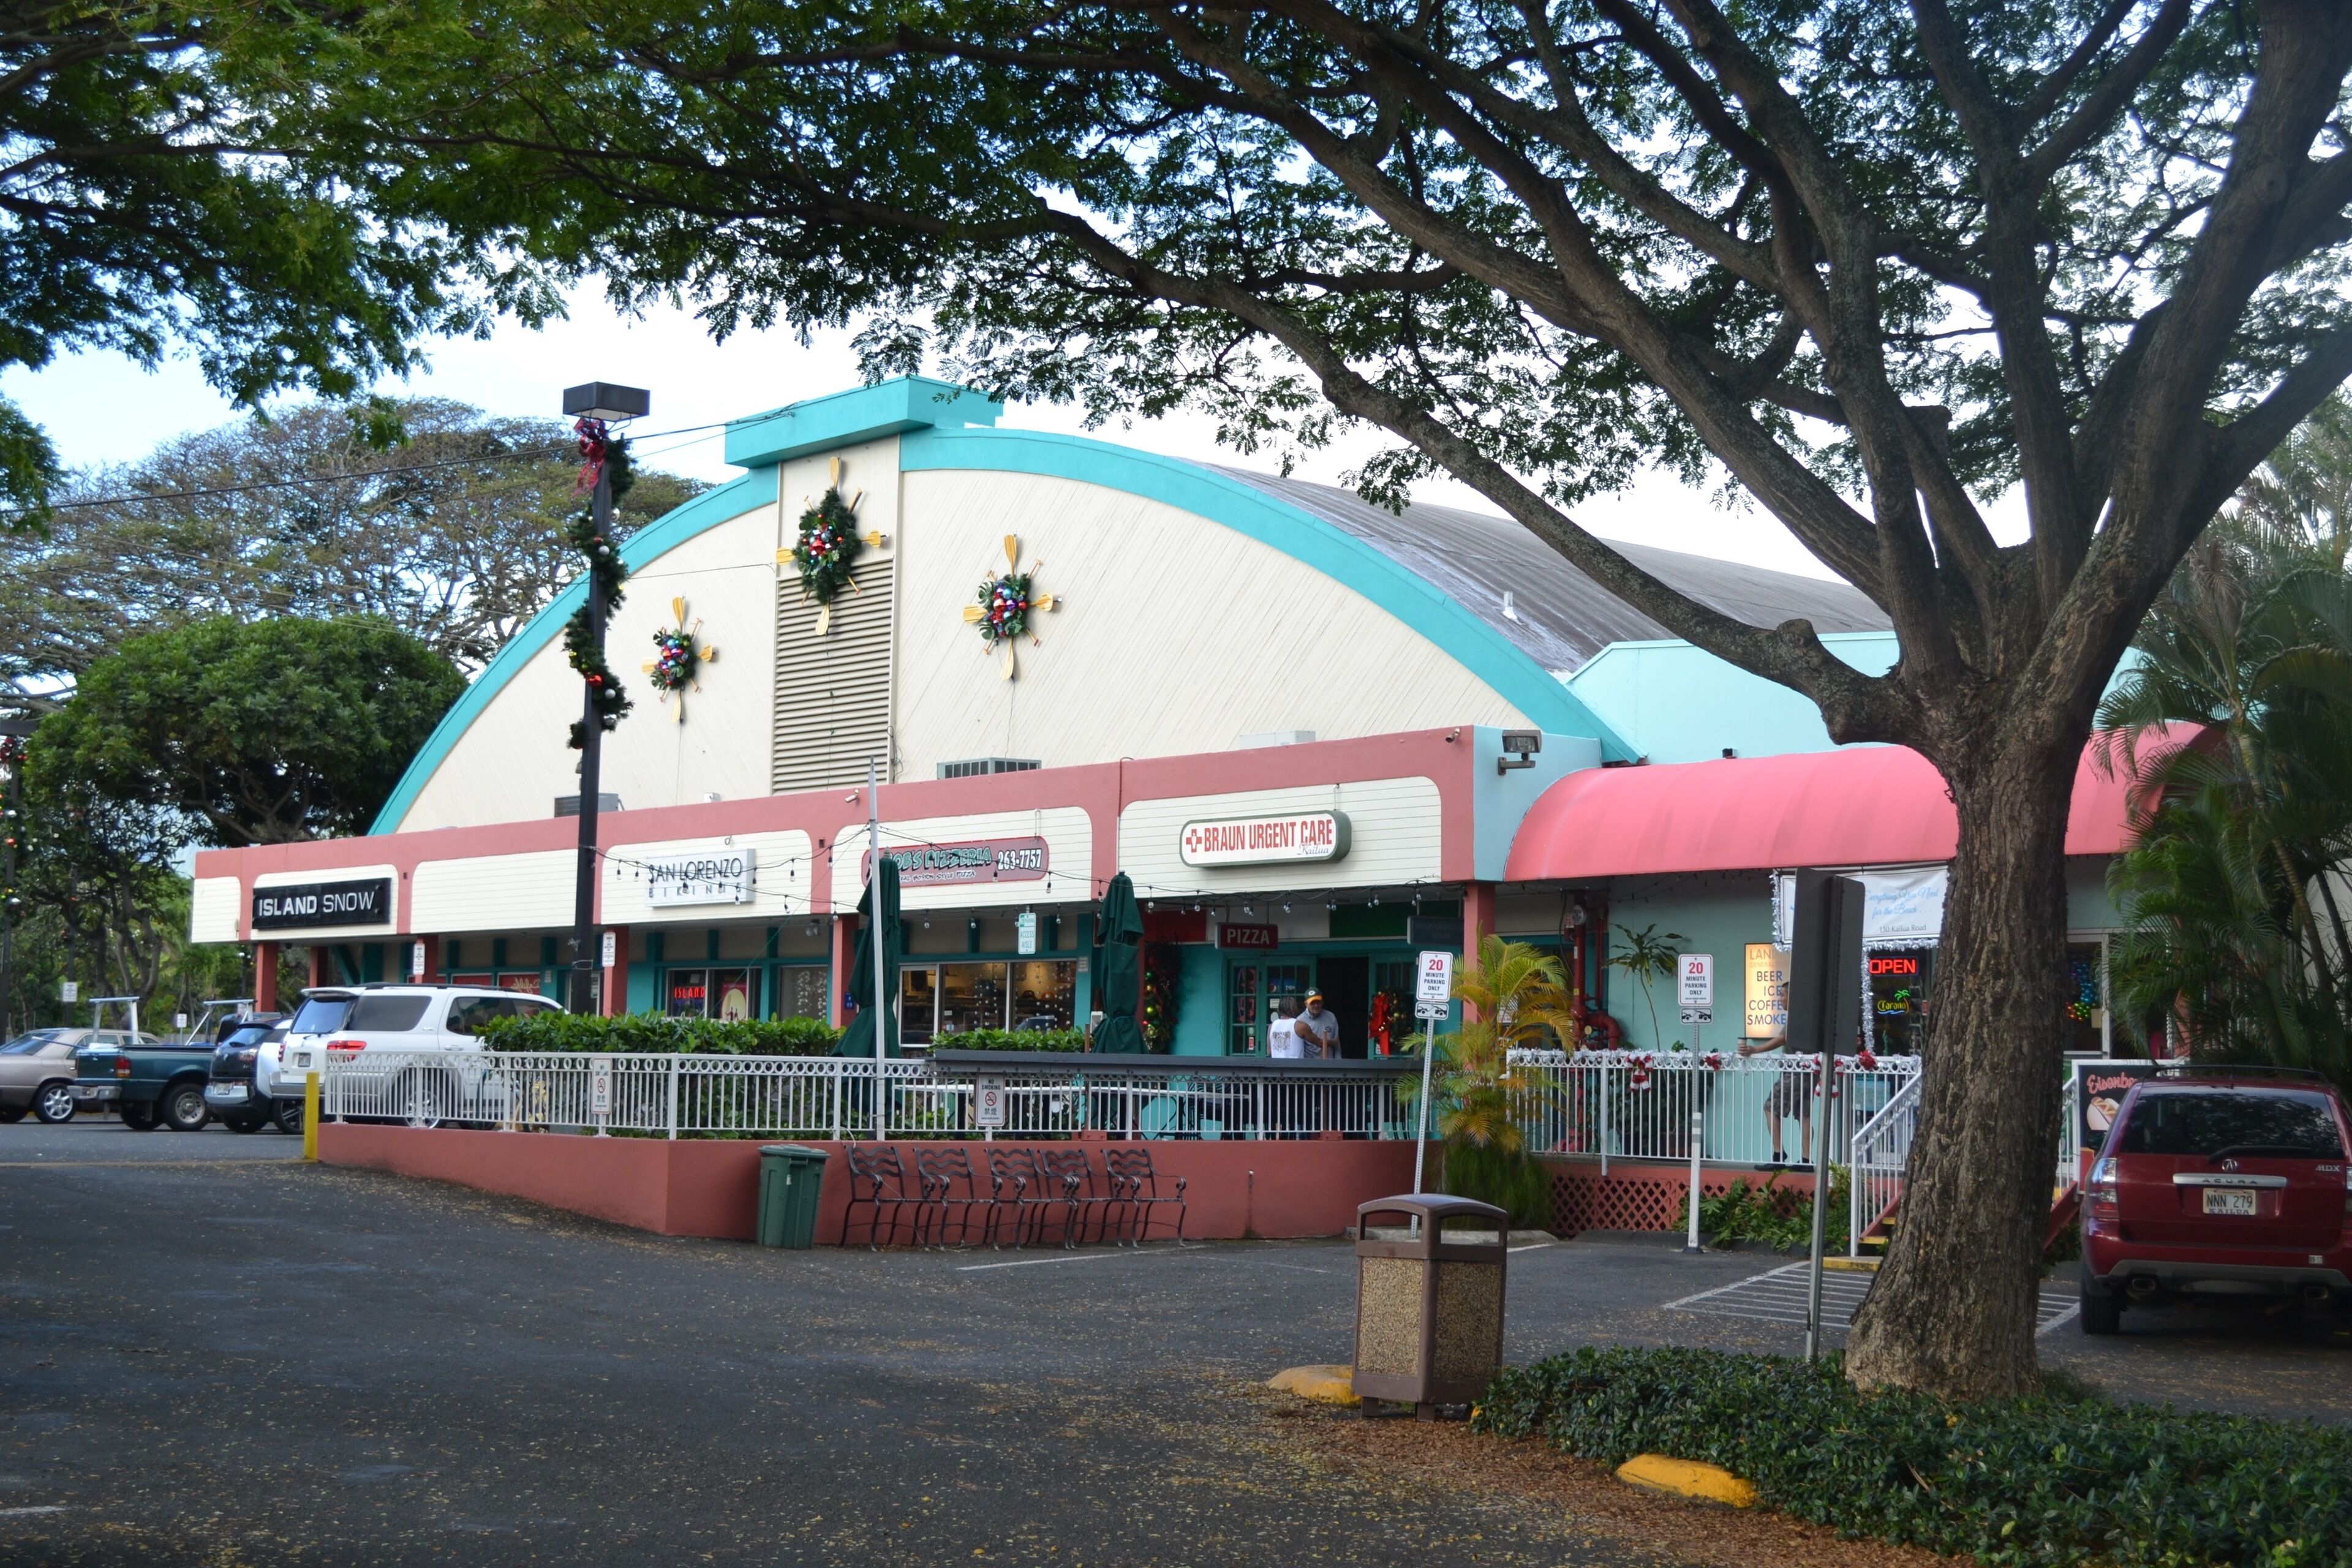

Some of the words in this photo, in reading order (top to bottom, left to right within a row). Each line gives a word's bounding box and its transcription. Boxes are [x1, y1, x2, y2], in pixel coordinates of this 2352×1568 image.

[1204, 825, 1245, 852] BRAUN
[1249, 821, 1297, 850] URGENT
[1300, 819, 1333, 846] CARE
[1297, 842, 1330, 856] Kailua
[889, 850, 922, 872] OB'S
[924, 846, 993, 870] PIZZERIA
[997, 848, 1042, 871] 263-7757
[648, 862, 676, 883] SAN
[679, 858, 742, 881] LORENZO
[935, 872, 954, 881] STYLE
[258, 895, 317, 917] ISLAND
[323, 891, 375, 913] SNOW
[1227, 929, 1270, 944] PIZZA
[1428, 959, 1444, 971] 20
[1688, 962, 1703, 974] 20
[1869, 959, 1916, 974] OPEN
[1757, 970, 1783, 982] BEER
[674, 987, 705, 998] ISLAND
[1763, 985, 1782, 997] ICE
[1749, 1000, 1783, 1011] COFFE
[2206, 1194, 2227, 1208] NNN
[2233, 1195, 2253, 1208] 279
